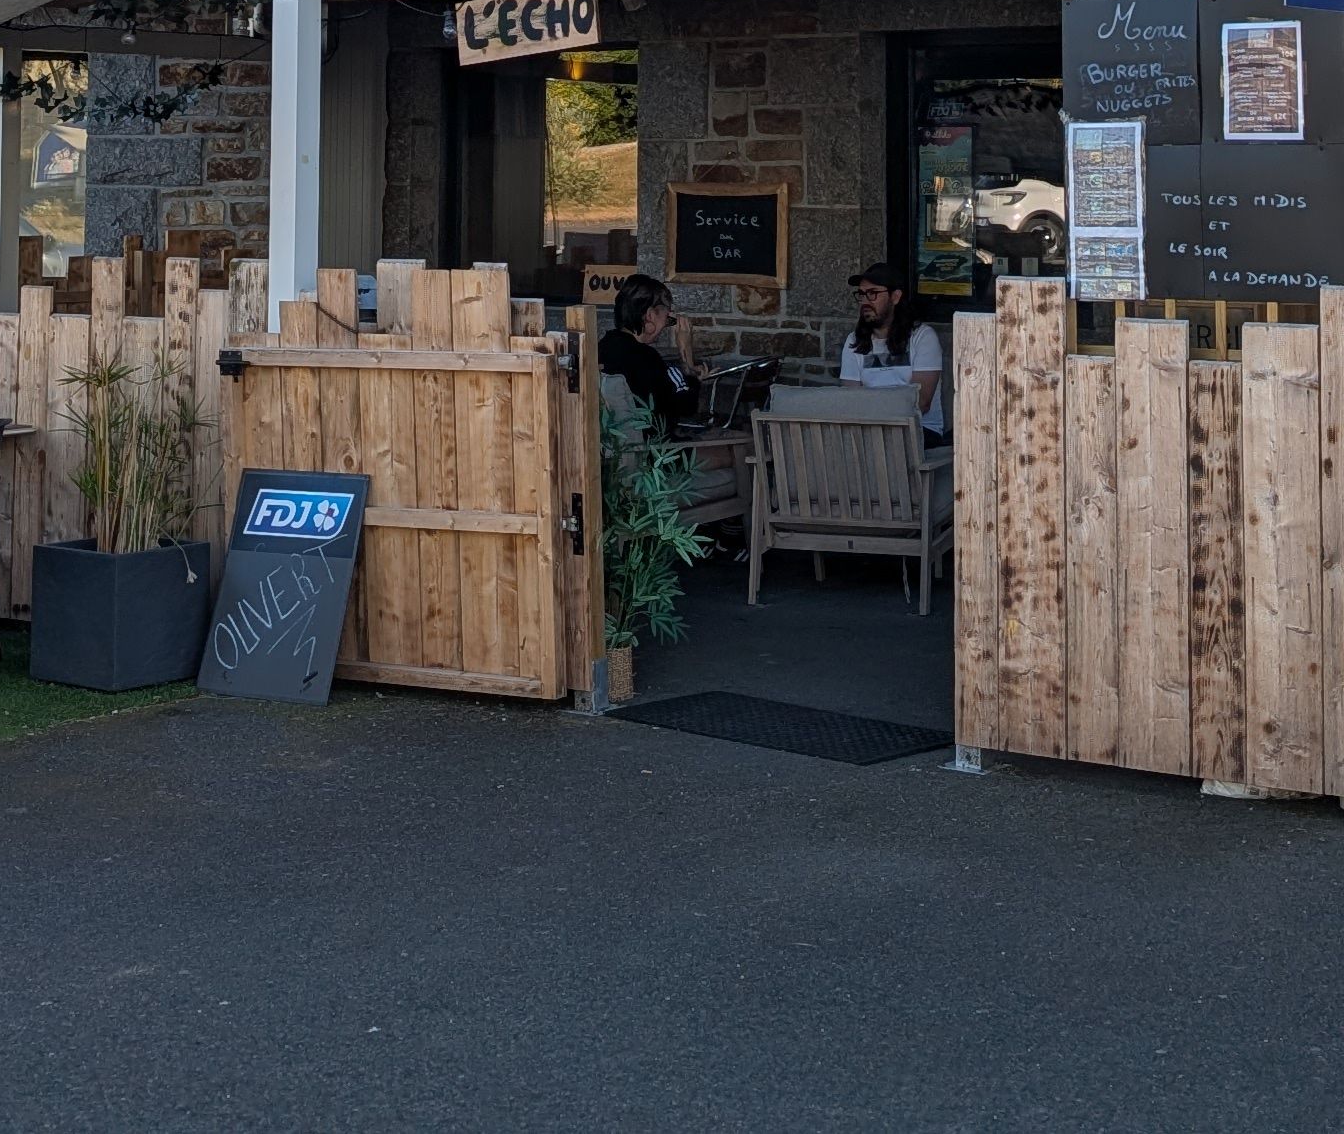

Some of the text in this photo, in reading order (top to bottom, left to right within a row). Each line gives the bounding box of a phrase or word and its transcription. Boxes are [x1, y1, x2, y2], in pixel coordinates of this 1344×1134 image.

[1097, 1, 1190, 41] Menu
[1086, 62, 1163, 85] BURGER
[1114, 81, 1136, 95] OU
[1095, 93, 1173, 113] NUGGETS
[1160, 192, 1307, 209] TOUS LES MIDIS
[695, 209, 760, 227] Service
[1208, 220, 1231, 232] ET
[712, 245, 742, 259] BAR
[1169, 242, 1229, 260] LE SOIR
[588, 273, 625, 292] OUV
[1223, 271, 1241, 282] LA
[1246, 270, 1331, 288] DEMANDE
[254, 498, 313, 529] FDJ
